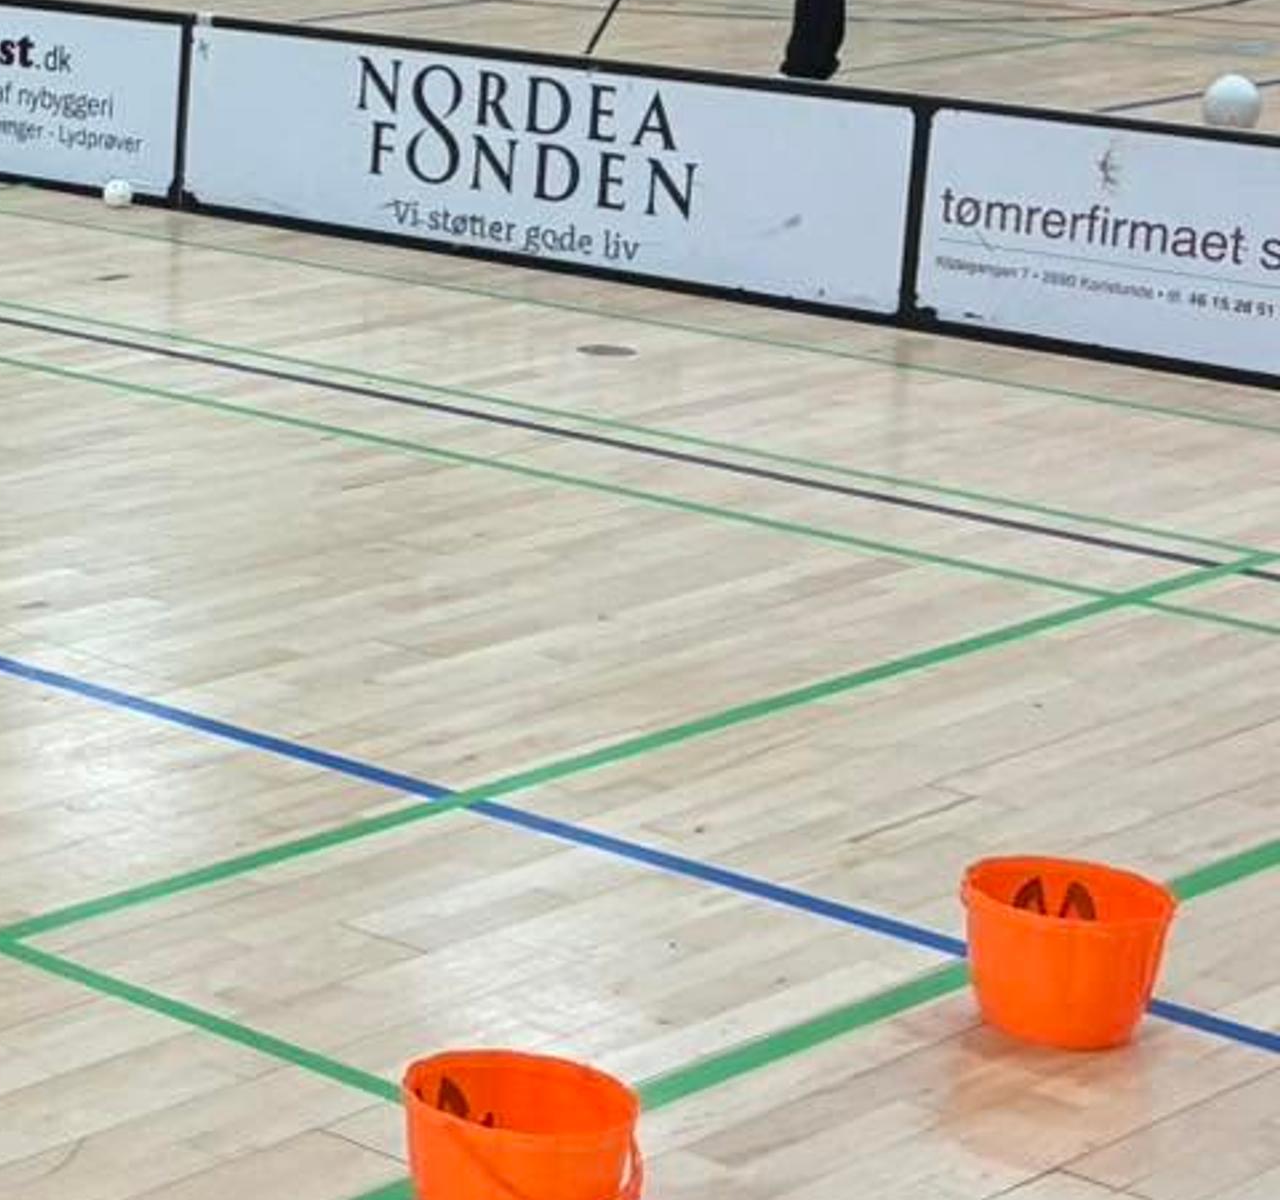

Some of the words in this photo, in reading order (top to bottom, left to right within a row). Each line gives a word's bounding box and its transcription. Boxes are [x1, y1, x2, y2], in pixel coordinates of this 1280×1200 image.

[357, 56, 678, 151] NORDEA
[369, 120, 700, 222] FONDEN
[391, 200, 422, 227] Vi
[522, 224, 593, 255] gode
[604, 230, 642, 262] liv
[940, 187, 1249, 265] tømrerfirmaet
